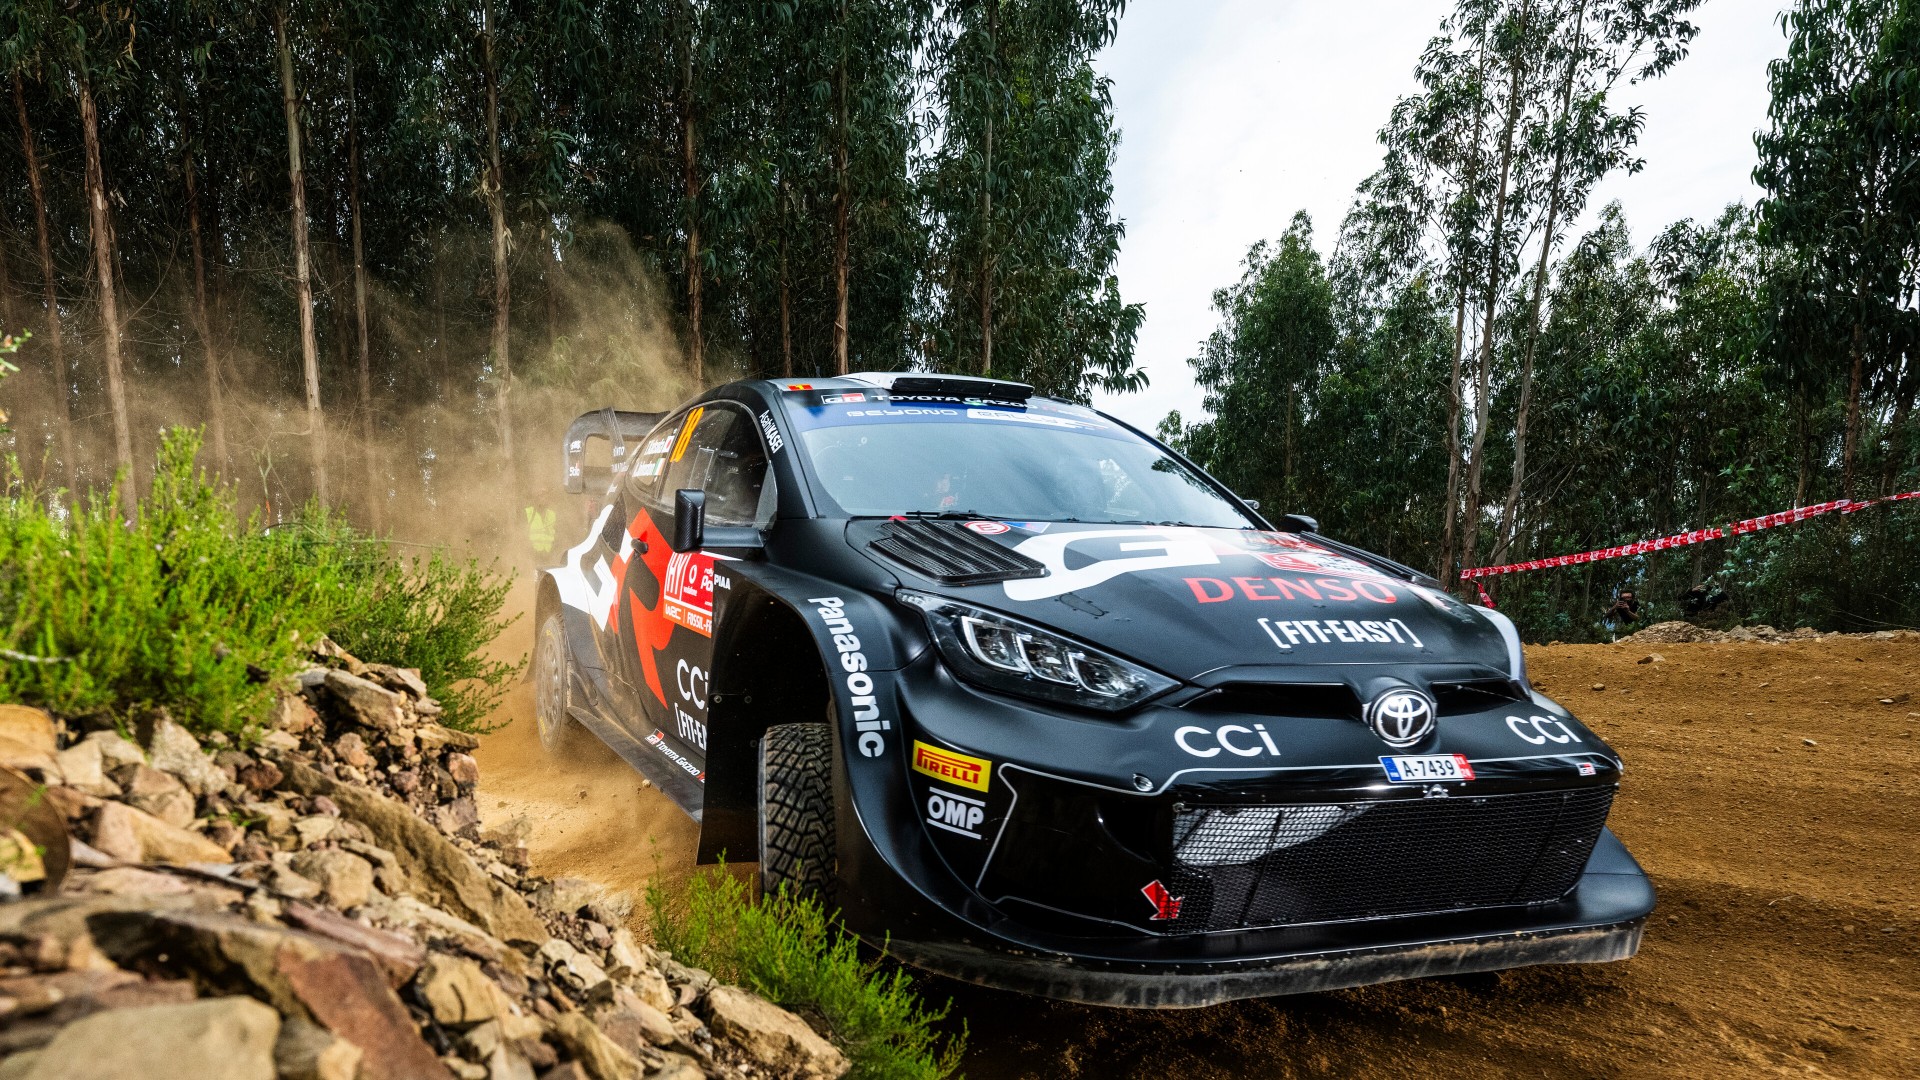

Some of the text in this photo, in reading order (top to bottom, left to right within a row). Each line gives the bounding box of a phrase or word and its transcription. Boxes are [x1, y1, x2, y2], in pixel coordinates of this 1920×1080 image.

[847, 409, 958, 417] BEYOND
[713, 574, 731, 590] PIAA
[1182, 577, 1397, 604] DENSO
[808, 597, 891, 758] Panasonic
[1174, 724, 1281, 757] CCi
[1505, 715, 1582, 745] CCi
[916, 747, 982, 784] PIRELLI
[1402, 760, 1455, 777] A-7439
[928, 794, 984, 830] OMP
